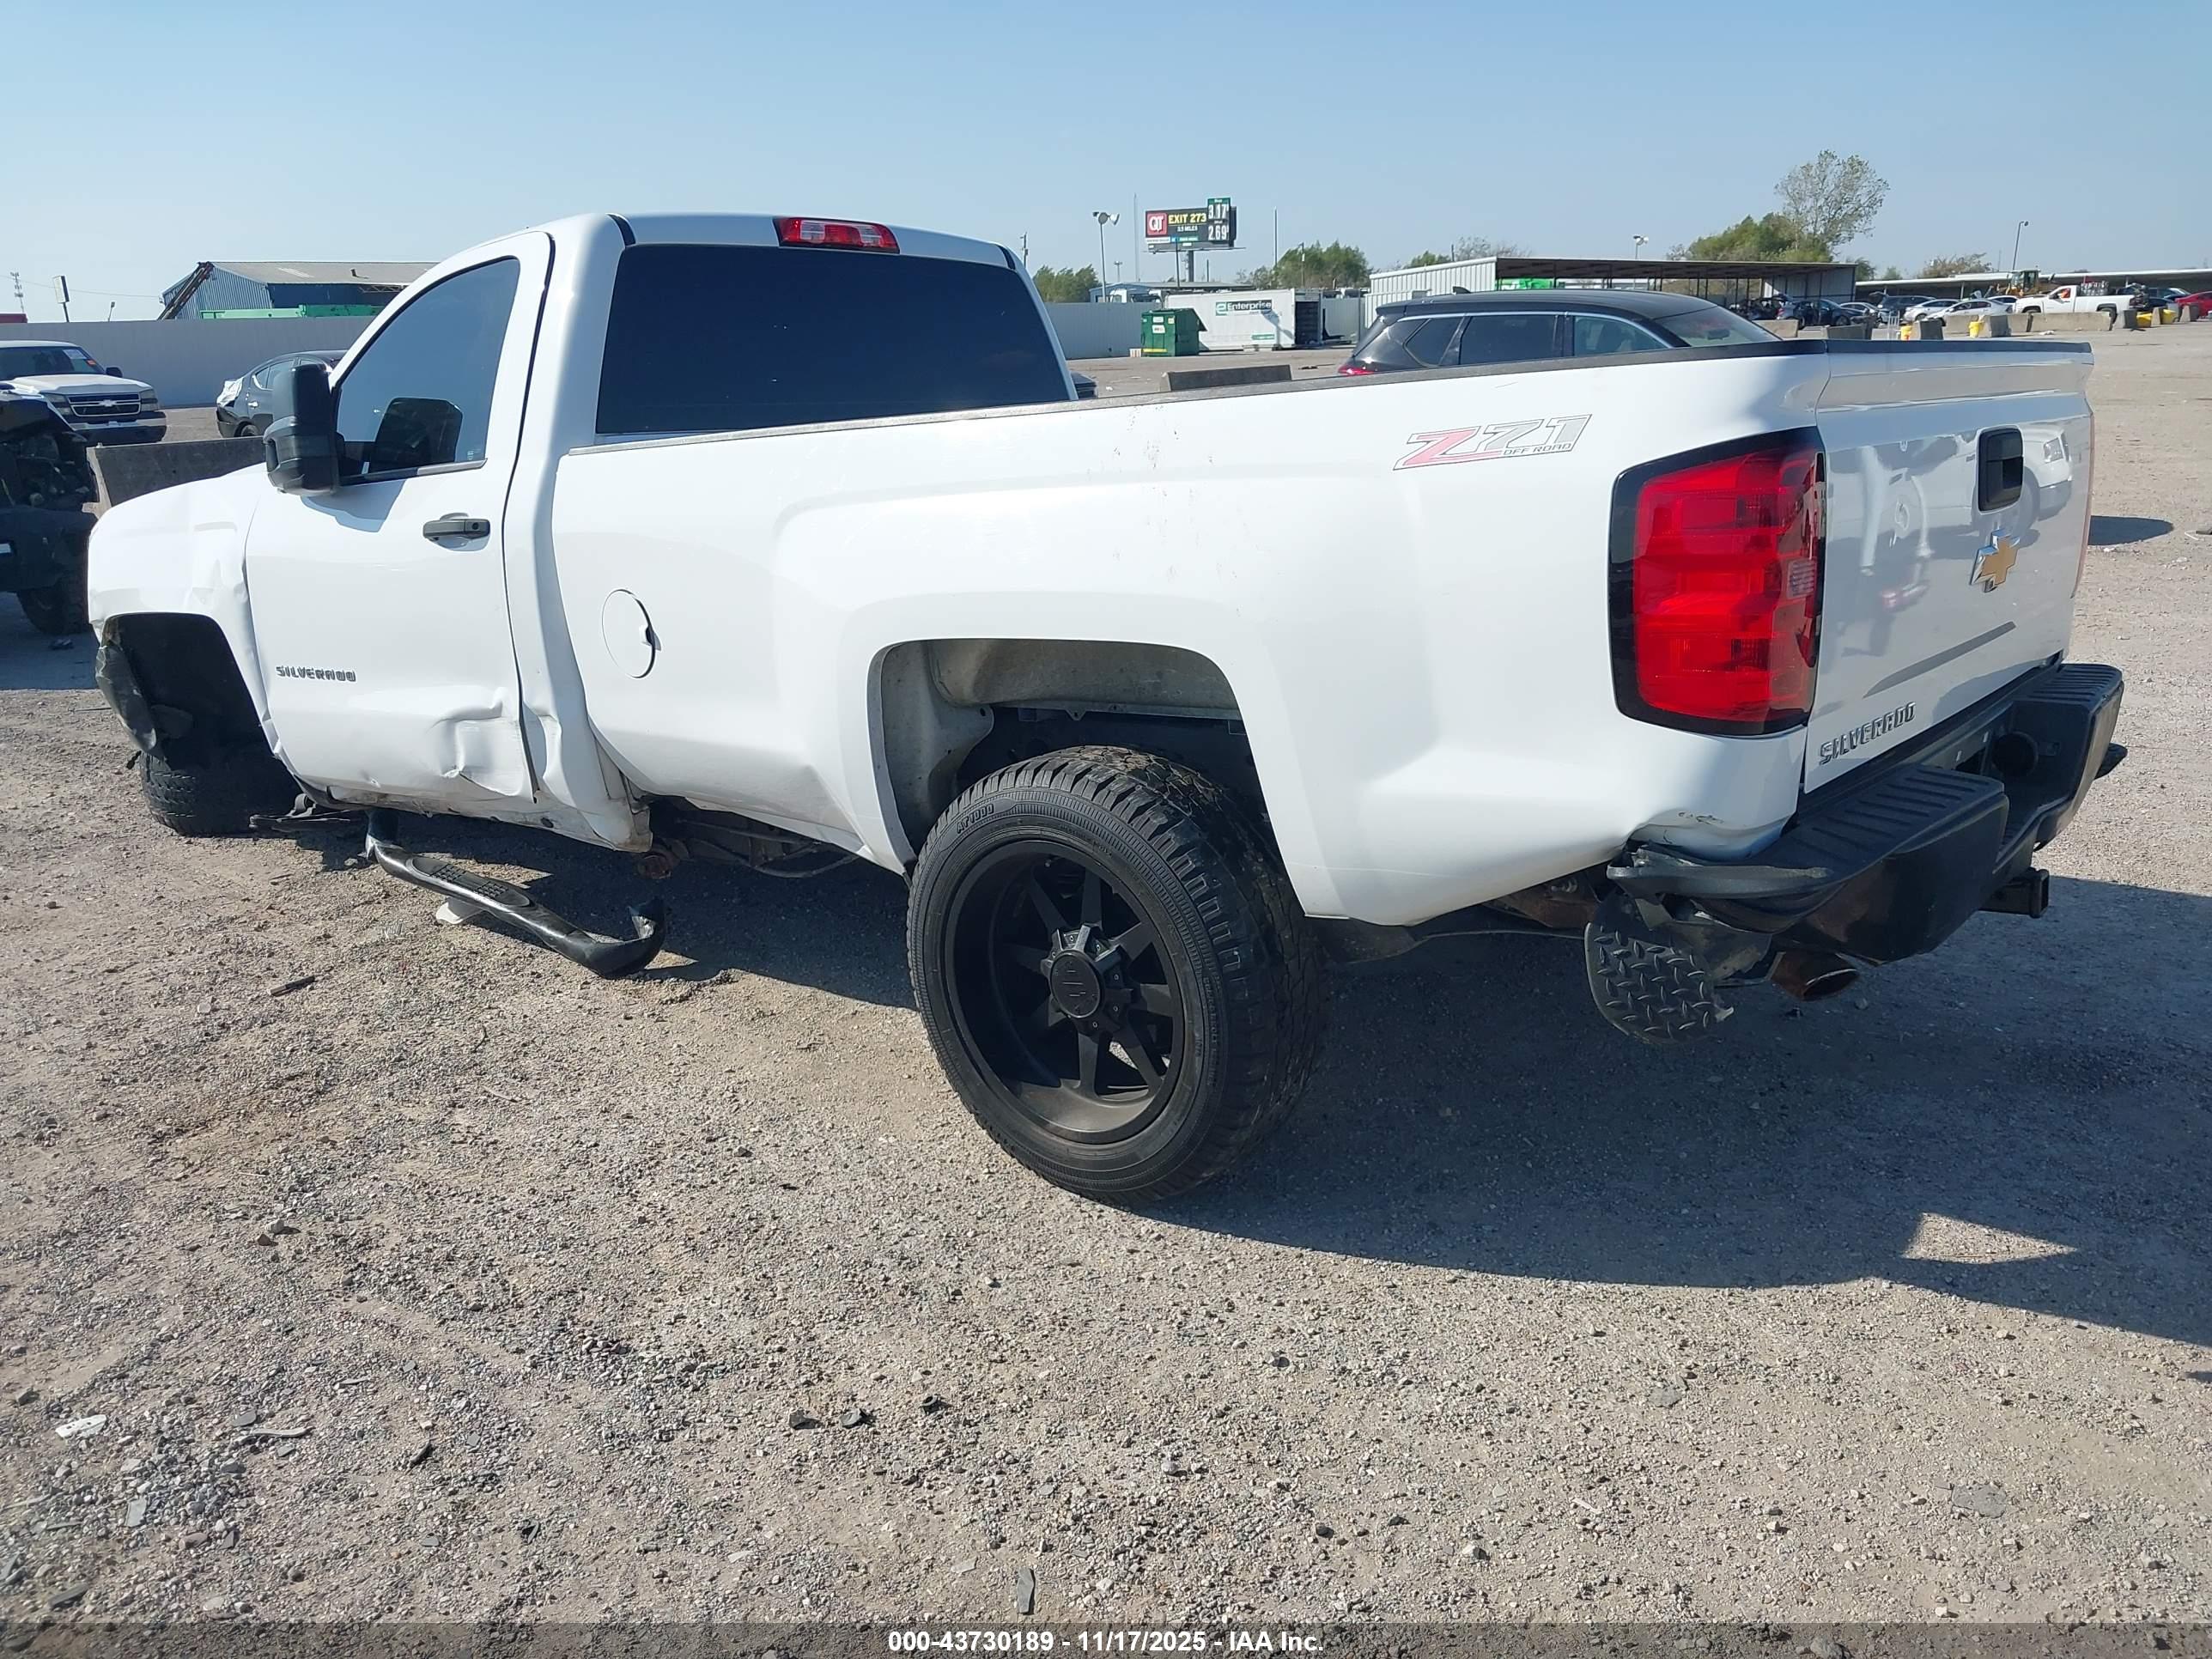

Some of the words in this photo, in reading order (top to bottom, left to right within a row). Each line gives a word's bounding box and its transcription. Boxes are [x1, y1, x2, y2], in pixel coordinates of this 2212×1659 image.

[1168, 215, 1188, 224] EXIT
[1189, 213, 1206, 223] 273
[1227, 301, 1272, 311] Enterprise
[1393, 413, 1592, 471] Z71
[1503, 447, 1528, 456] OFF
[1532, 442, 1572, 453] ROAD
[276, 666, 356, 683] SILVERADO
[1819, 701, 1916, 765] SILVERADO
